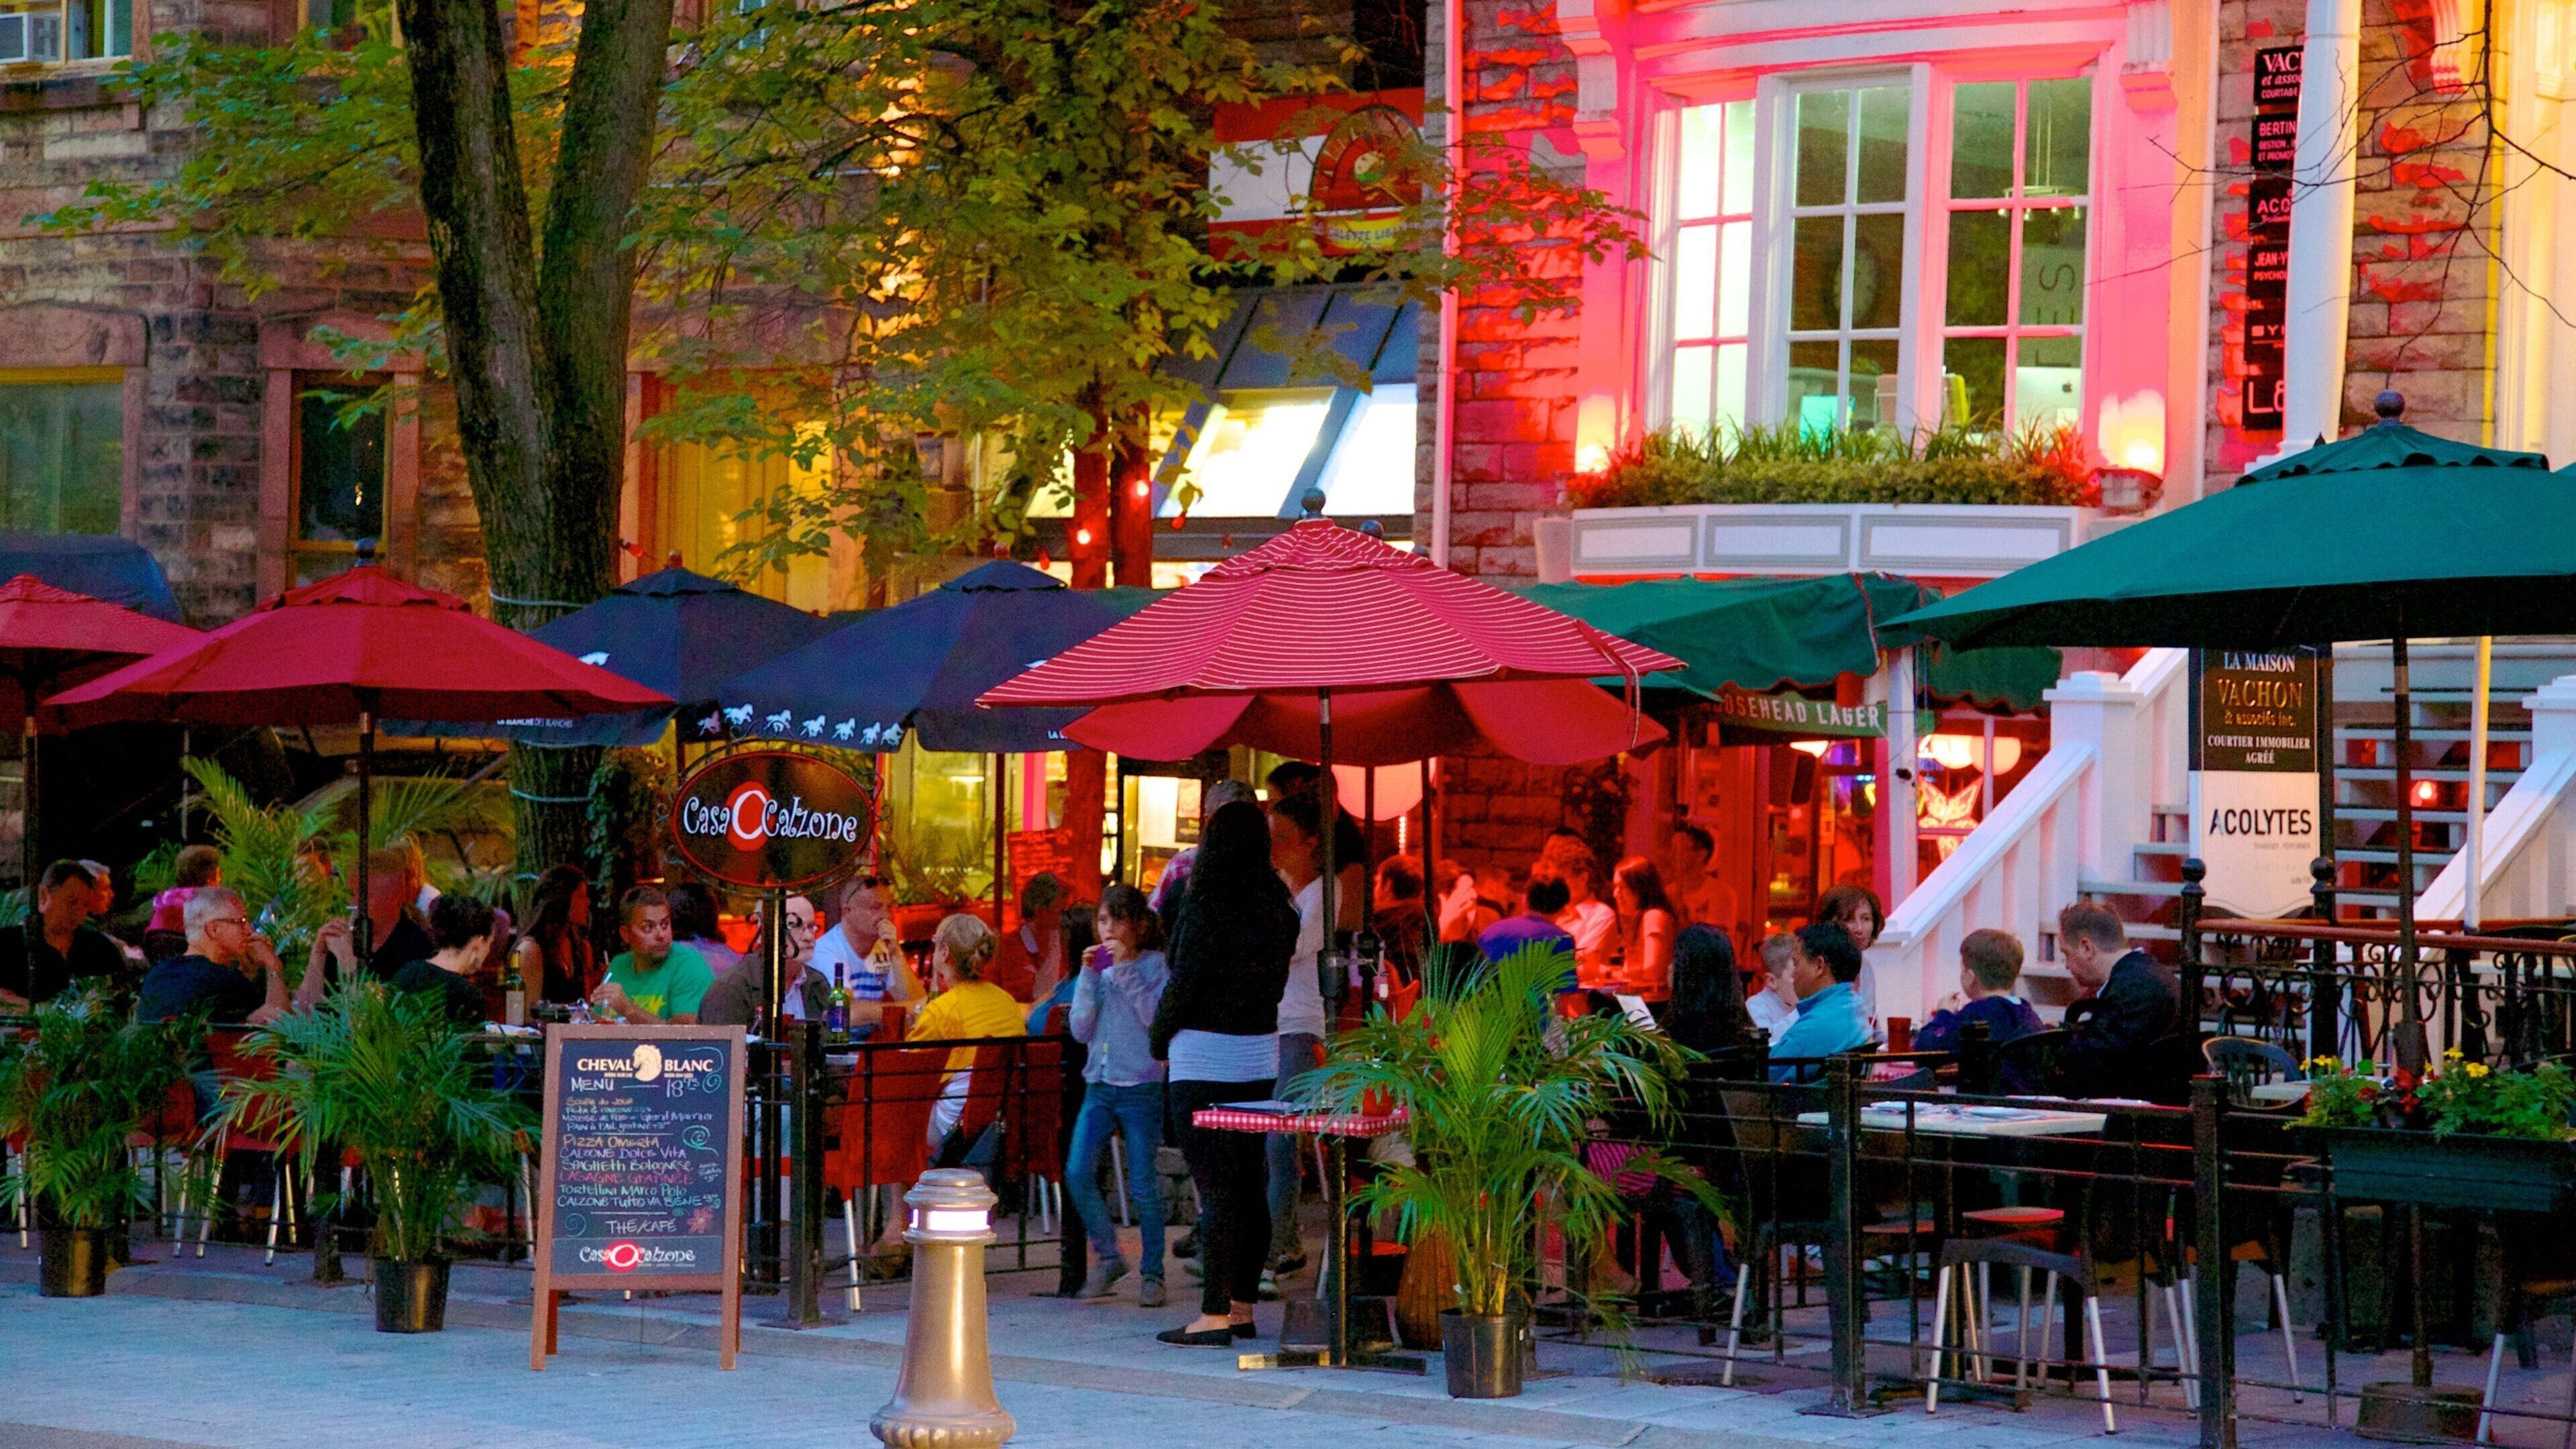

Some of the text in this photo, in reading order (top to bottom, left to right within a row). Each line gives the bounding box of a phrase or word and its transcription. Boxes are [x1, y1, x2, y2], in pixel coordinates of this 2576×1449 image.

[2224, 652, 2296, 672] LA MAISON
[2217, 678, 2302, 708] VACHON
[1817, 702, 1880, 729] LAGER
[2224, 709, 2233, 725] &
[2236, 710, 2276, 726] associés
[2208, 735, 2310, 749] COURTIER IMMOBILIER
[2245, 749, 2275, 764] AGRÉÉ
[684, 796, 731, 836] Casa
[762, 796, 858, 843] Calzone
[2209, 808, 2312, 835] ACOLYTES
[577, 1059, 714, 1072] CHEVAL BLANC
[571, 1077, 614, 1092] MENU
[562, 1133, 603, 1147] PIZZA
[580, 1246, 612, 1263] Casa
